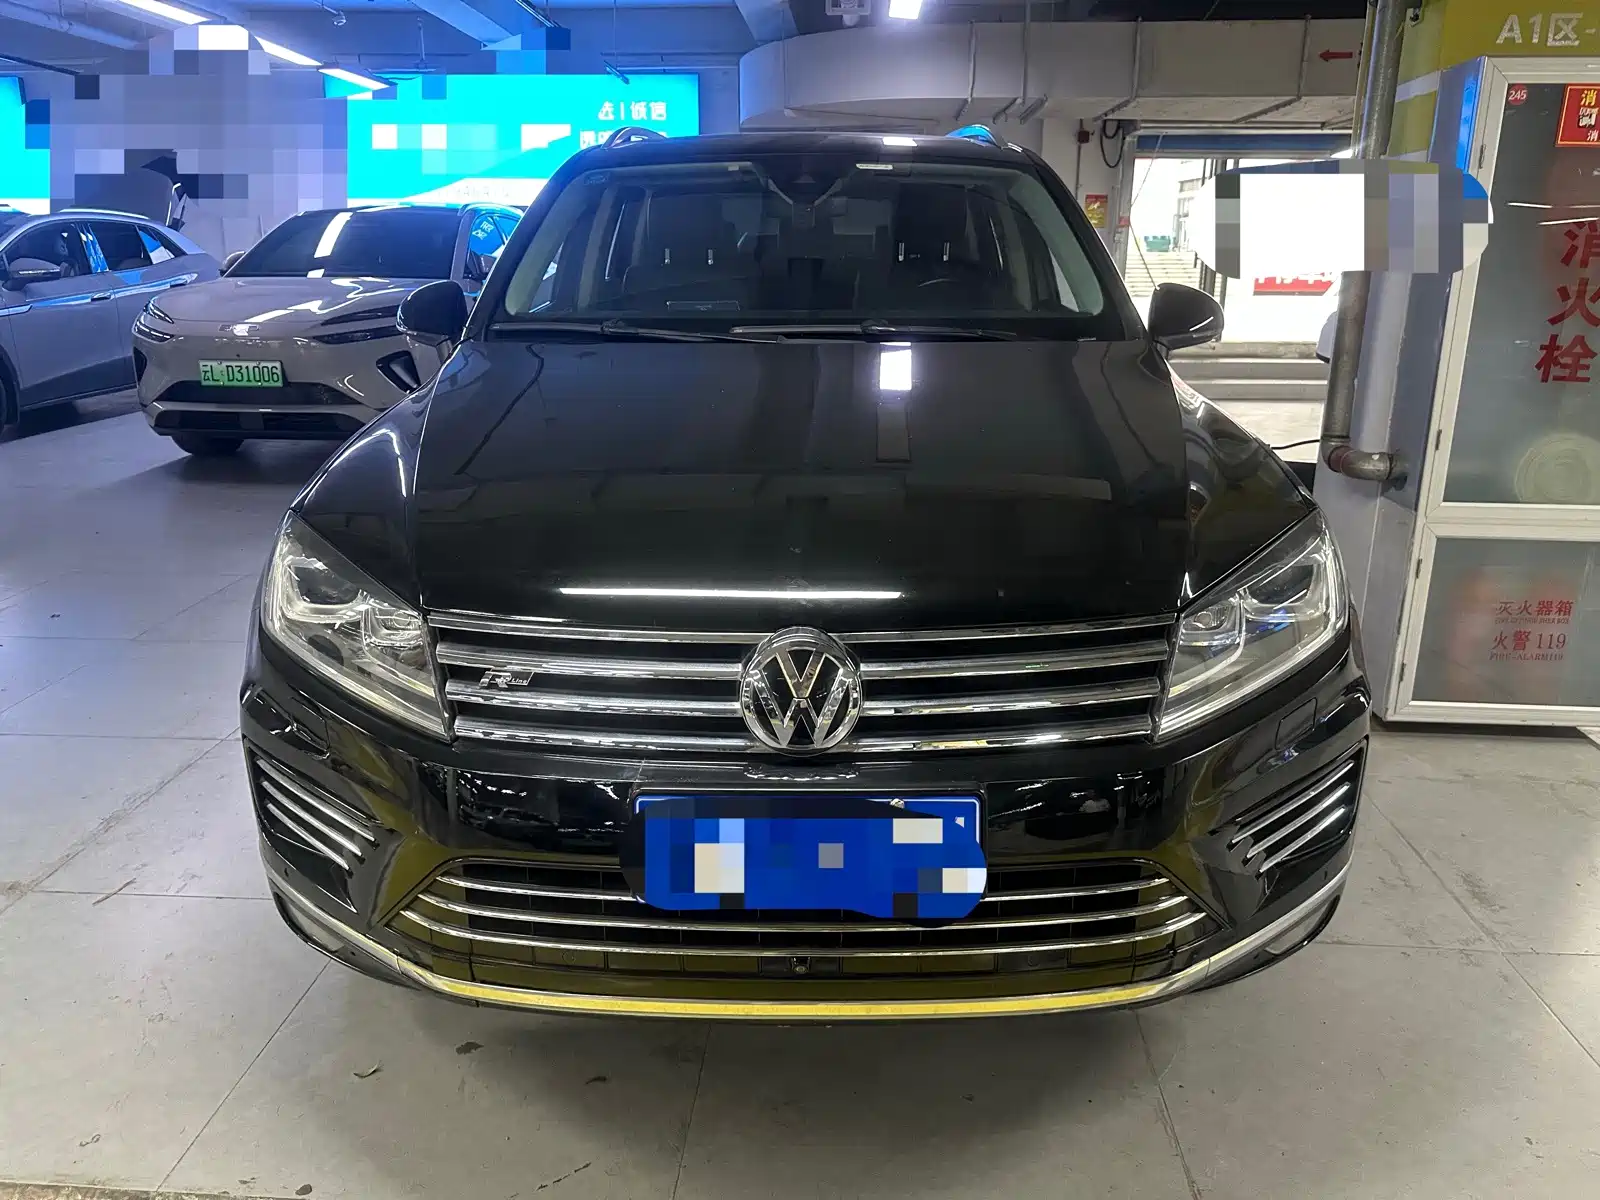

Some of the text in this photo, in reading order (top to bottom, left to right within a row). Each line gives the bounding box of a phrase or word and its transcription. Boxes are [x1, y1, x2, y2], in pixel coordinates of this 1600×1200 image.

[1508, 90, 1528, 100] 245
[1495, 600, 1574, 616] 灭火器箱
[1491, 630, 1567, 651] 火警 119
